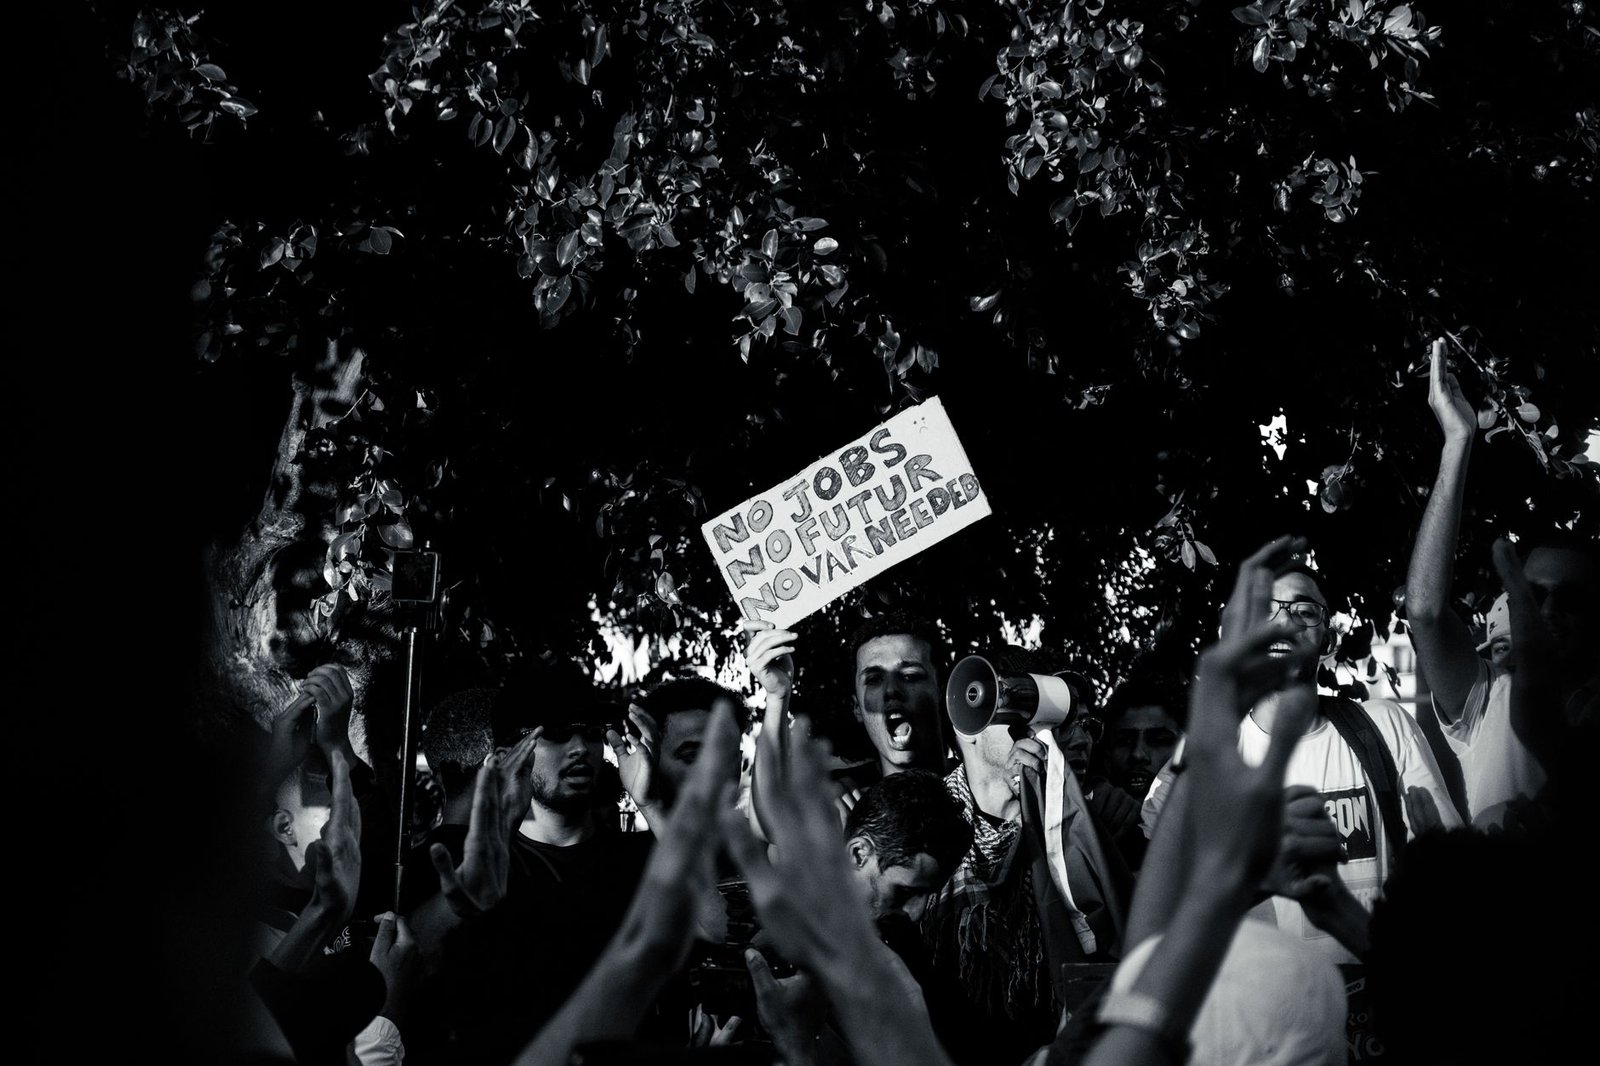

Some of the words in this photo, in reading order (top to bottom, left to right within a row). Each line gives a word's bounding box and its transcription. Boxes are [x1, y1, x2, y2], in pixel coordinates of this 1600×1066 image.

[712, 499, 774, 553] NO
[782, 427, 907, 523] JOBS
[725, 528, 792, 589] NO
[795, 454, 943, 556] FUTUR
[740, 567, 803, 621] NO
[864, 472, 980, 555] NEEDED
